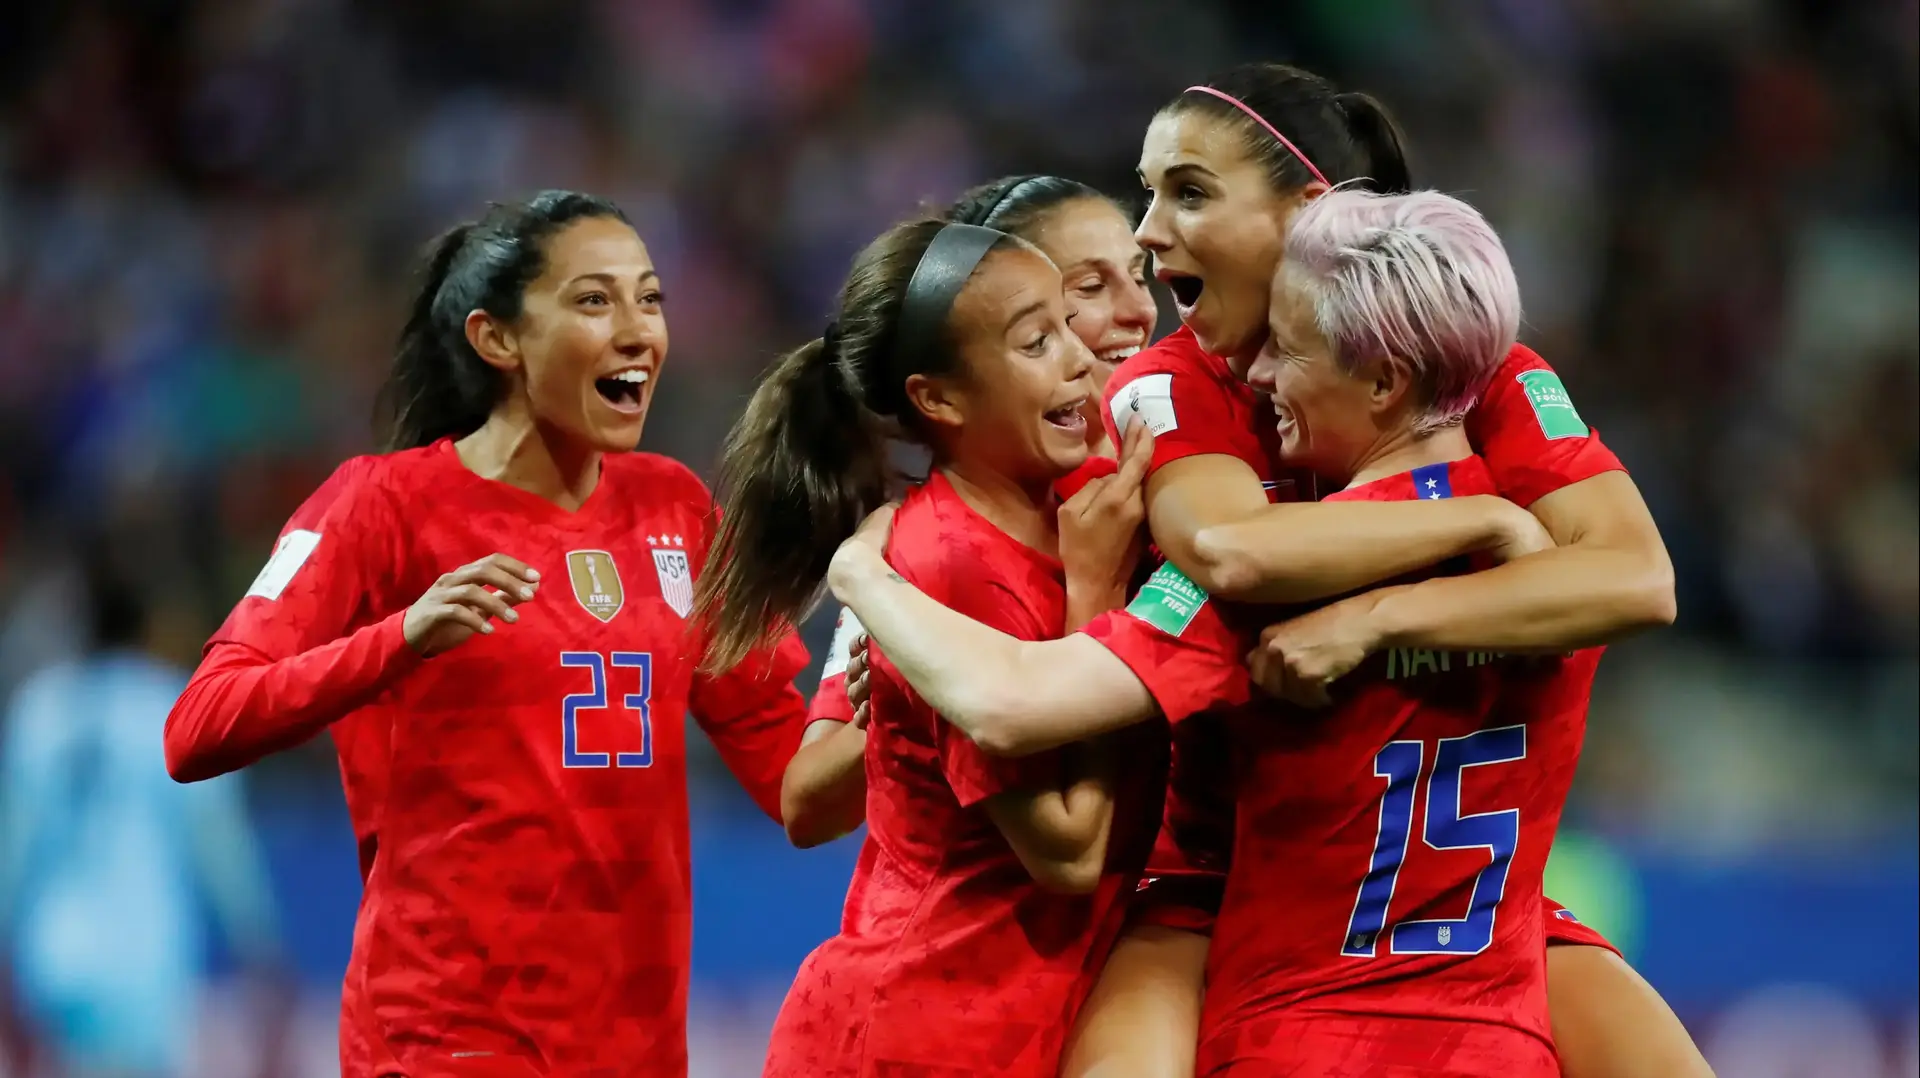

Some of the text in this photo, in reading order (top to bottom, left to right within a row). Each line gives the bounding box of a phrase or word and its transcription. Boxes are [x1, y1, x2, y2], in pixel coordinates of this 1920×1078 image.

[656, 554, 688, 579] USA
[589, 594, 612, 603] FIFA
[1161, 595, 1190, 617] FIFA
[560, 651, 653, 768] 23
[1341, 723, 1526, 957] 15
